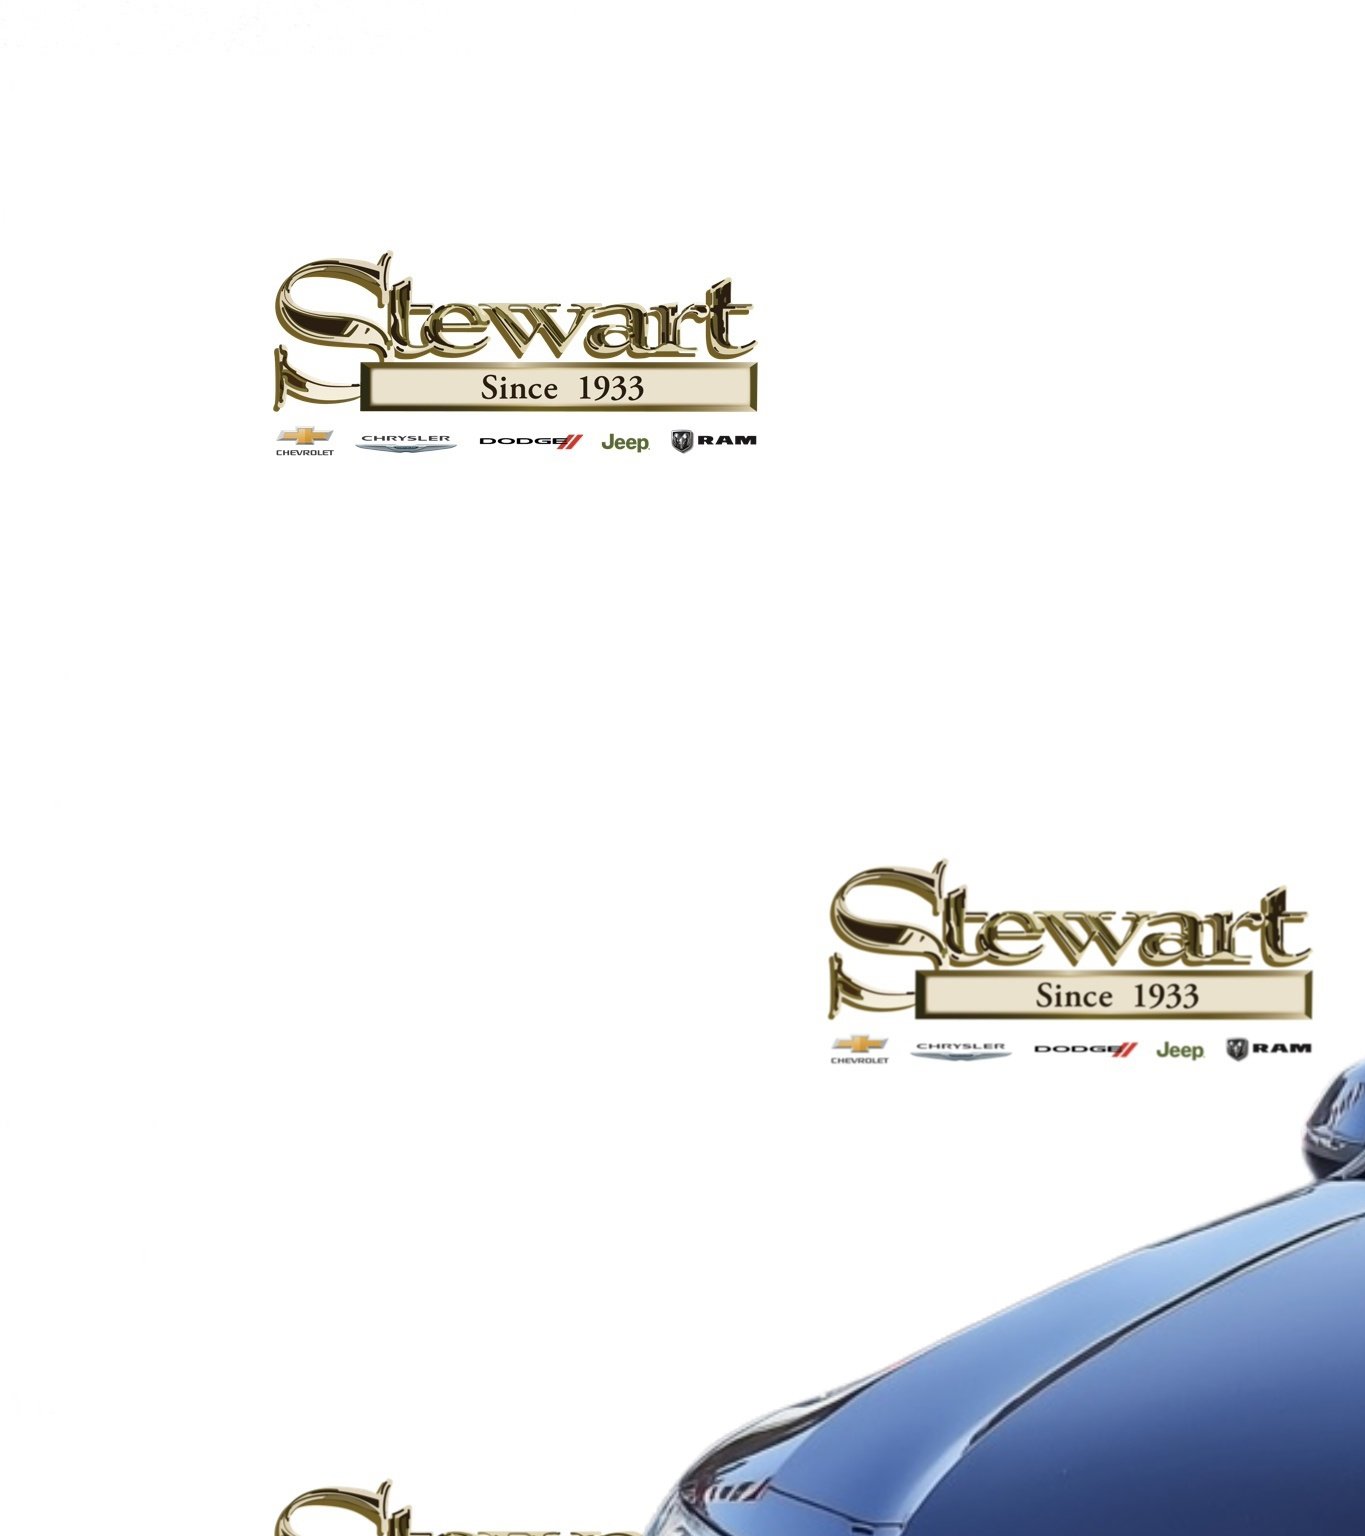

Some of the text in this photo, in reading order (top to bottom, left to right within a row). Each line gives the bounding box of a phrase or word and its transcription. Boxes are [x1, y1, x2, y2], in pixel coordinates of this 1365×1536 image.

[274, 249, 758, 410] Stewart
[481, 374, 644, 401] Since 1933
[479, 436, 567, 445] DODGE
[601, 433, 650, 453] Jeep
[698, 436, 757, 446] RAM
[829, 857, 1313, 1018] Stewart
[1036, 982, 1199, 1009] Since 1933
[1034, 1044, 1122, 1053] DODGE
[1156, 1041, 1205, 1061] Jeep
[1253, 1044, 1312, 1054] RAM
